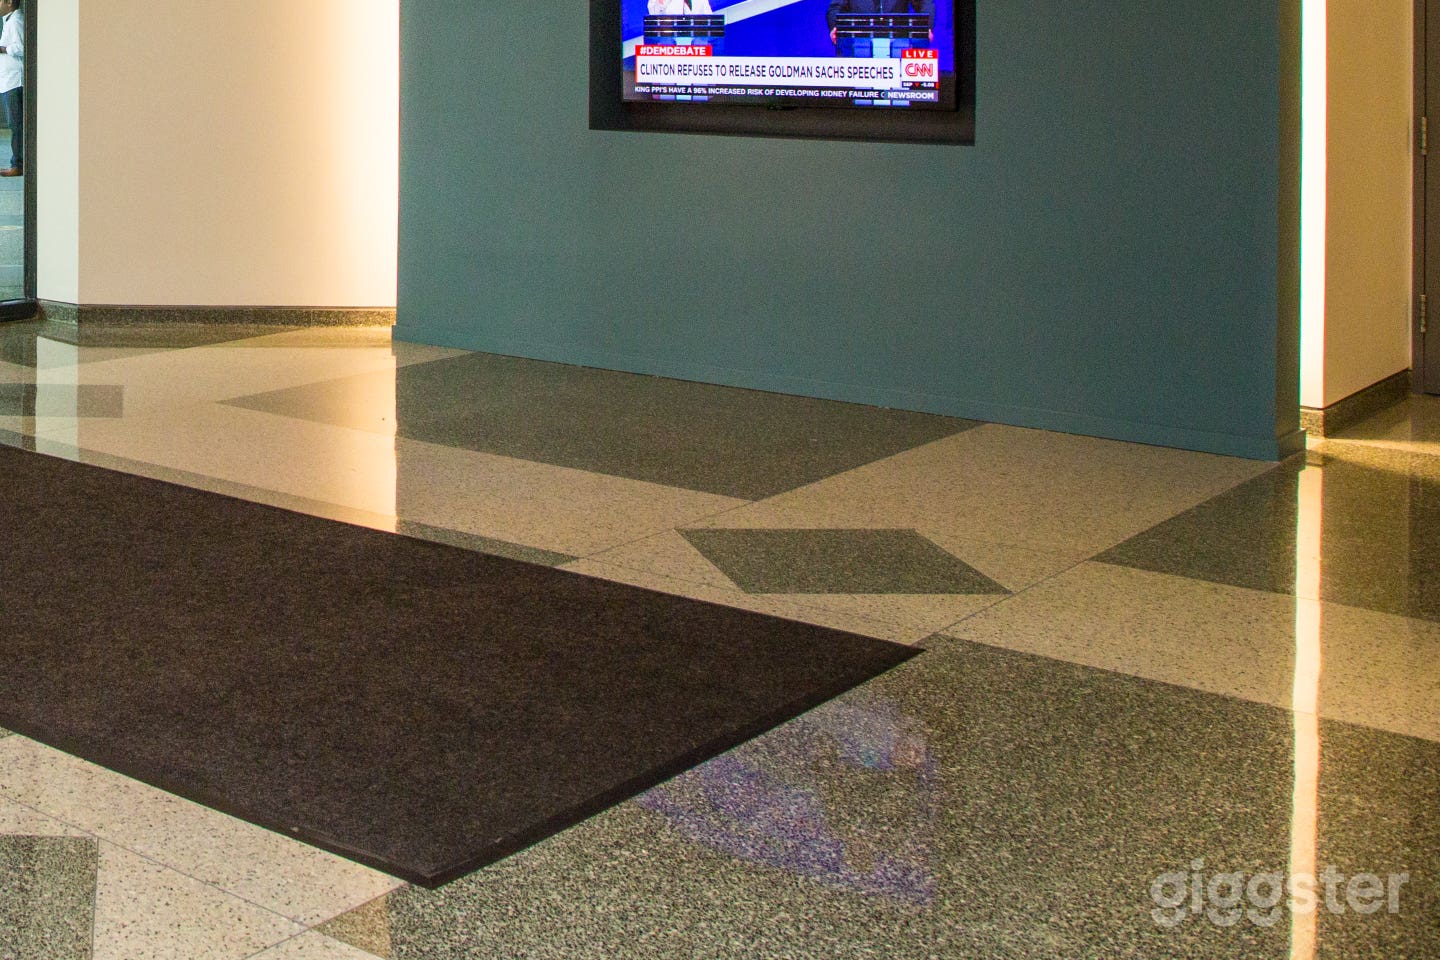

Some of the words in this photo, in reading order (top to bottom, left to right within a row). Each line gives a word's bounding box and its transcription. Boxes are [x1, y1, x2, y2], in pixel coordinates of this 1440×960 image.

[640, 47, 706, 56] #DEMDEBATE
[906, 50, 933, 58] LIVE
[640, 64, 675, 75] CLINTON
[677, 64, 713, 76] REFUSES
[716, 65, 726, 76] TO
[729, 65, 766, 77] RELEASE
[768, 65, 813, 78] GOLDMAN
[815, 66, 845, 79] SACHS
[847, 66, 894, 79] SPEECHES
[905, 63, 933, 77] CNN
[708, 87, 746, 95] INCREASED
[848, 90, 879, 98] FAILURE
